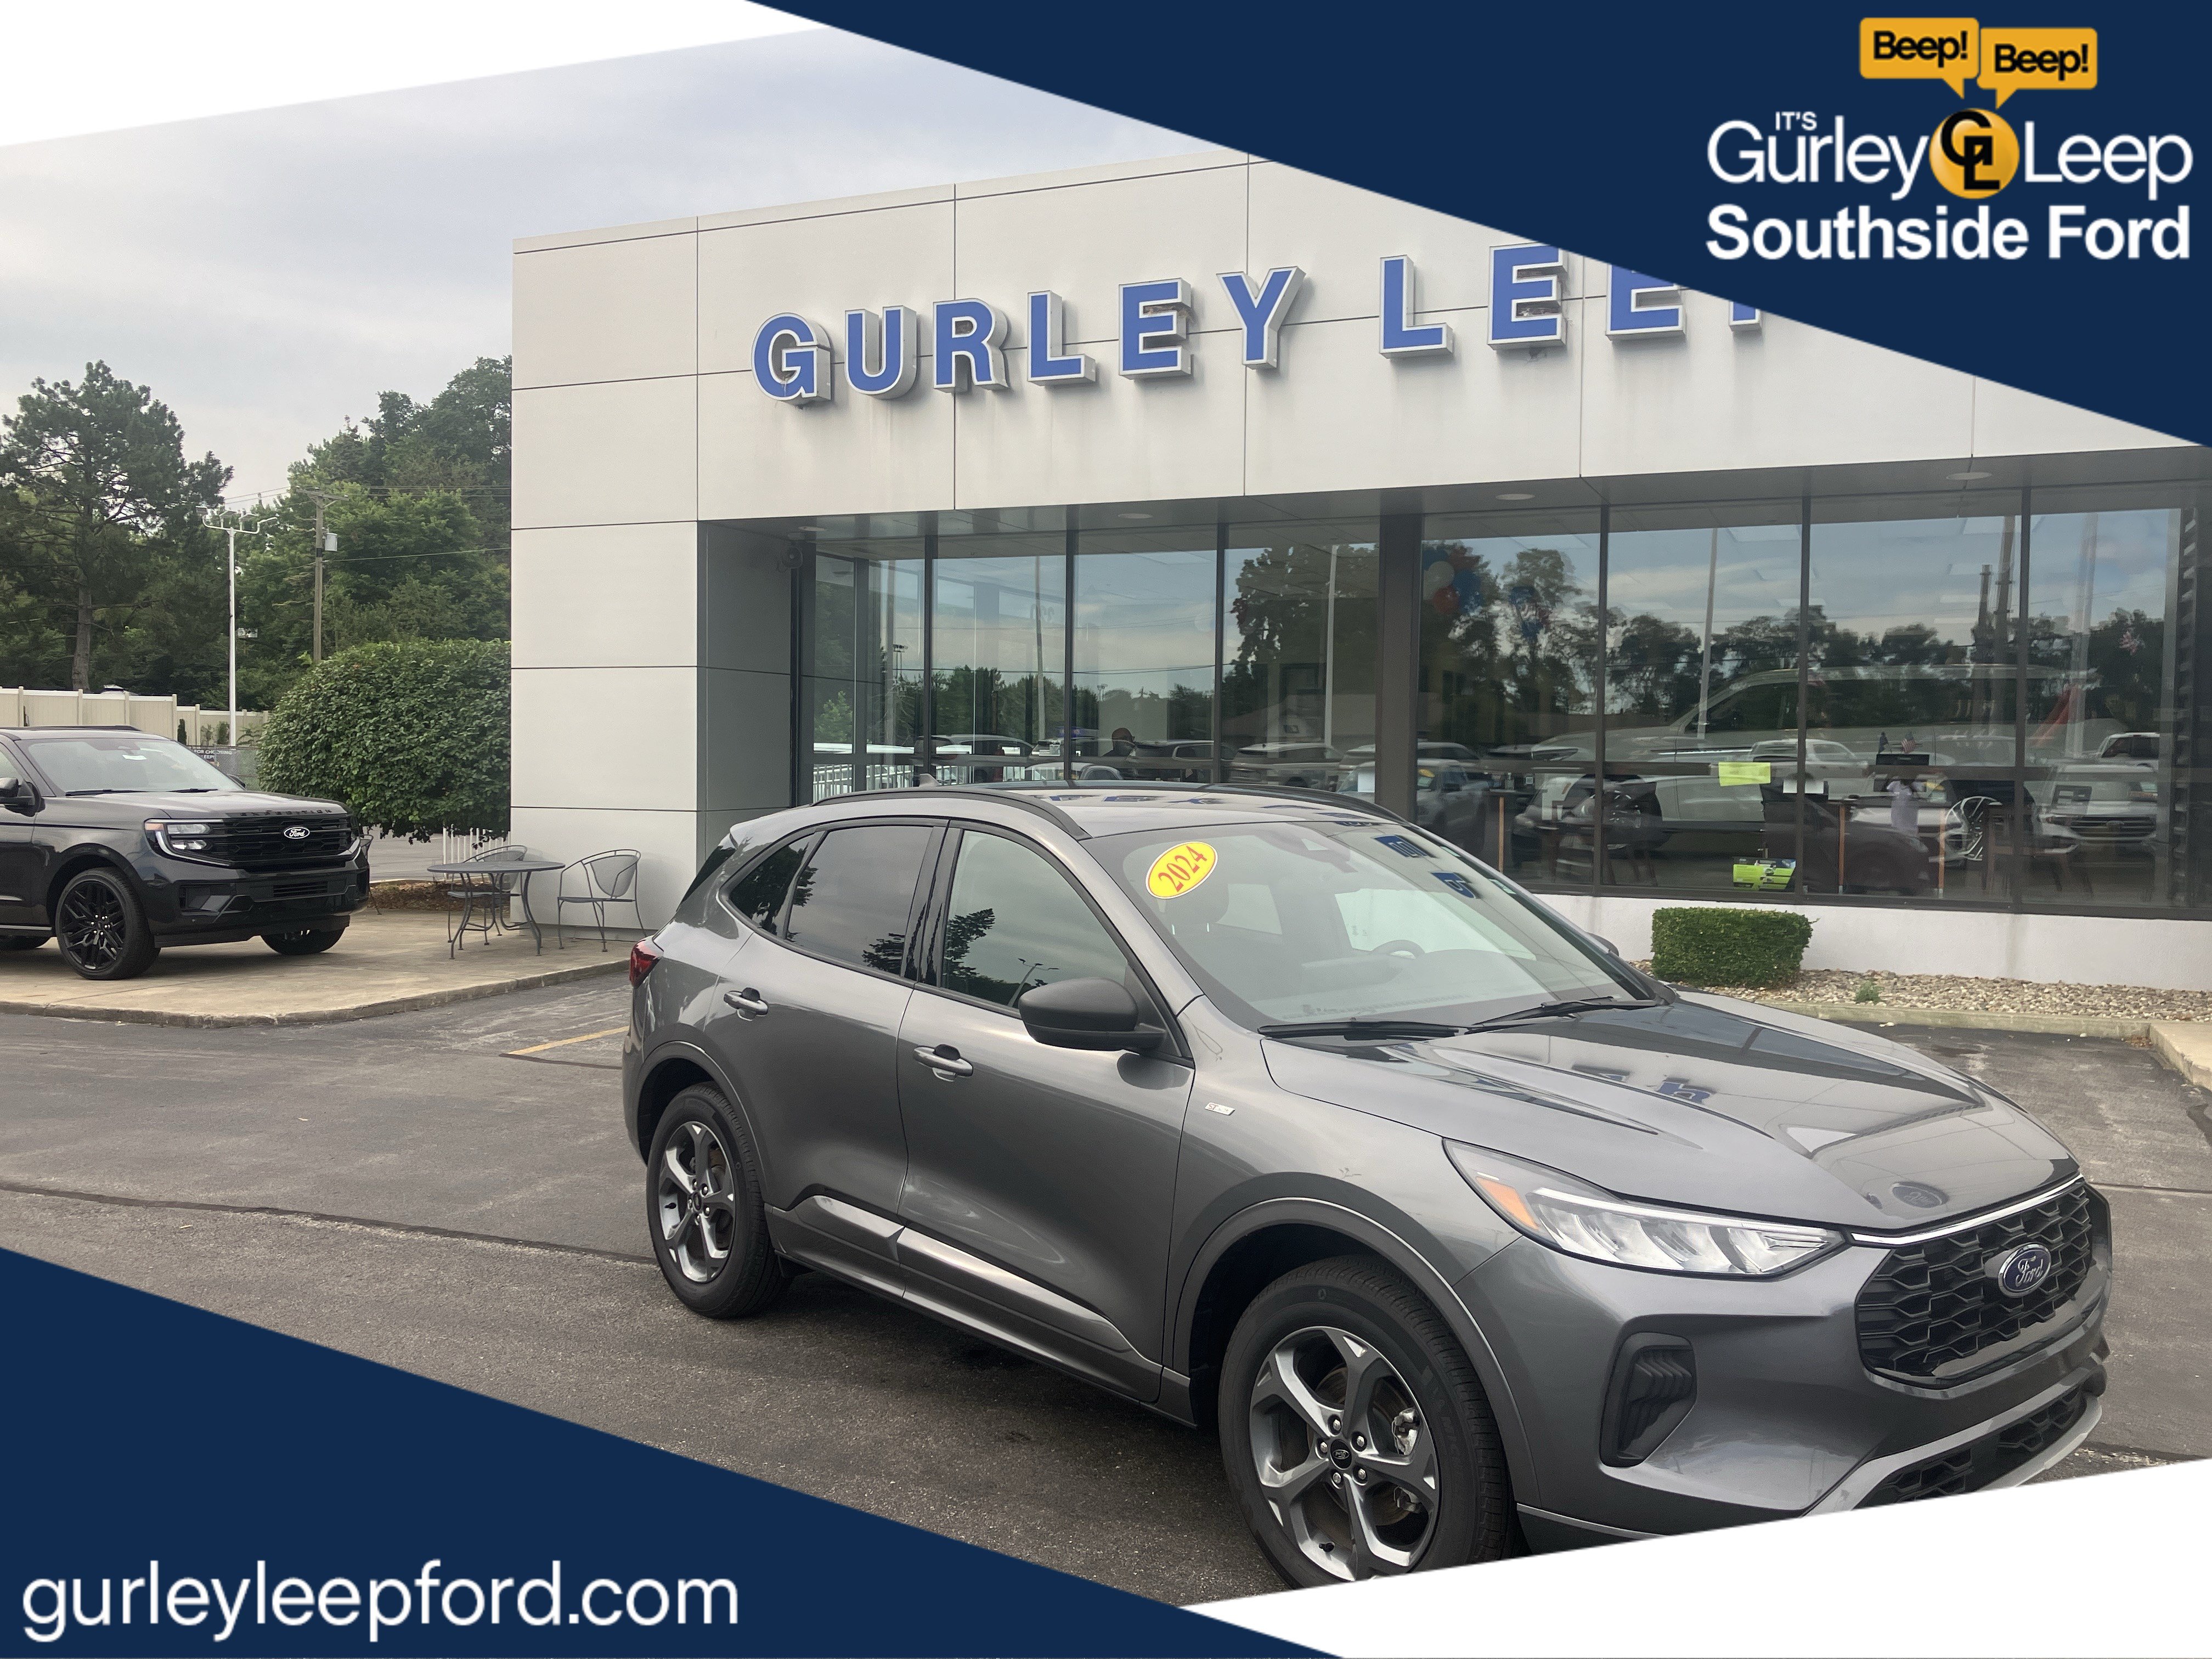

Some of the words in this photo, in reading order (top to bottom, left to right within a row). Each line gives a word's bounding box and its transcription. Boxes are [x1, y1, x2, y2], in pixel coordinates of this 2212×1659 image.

[752, 266, 1306, 406] GURLEY
[1380, 242, 1760, 359] LEE
[289, 828, 306, 837] Ford
[1158, 845, 1207, 892] 2024
[2015, 1256, 2044, 1287] Ford
